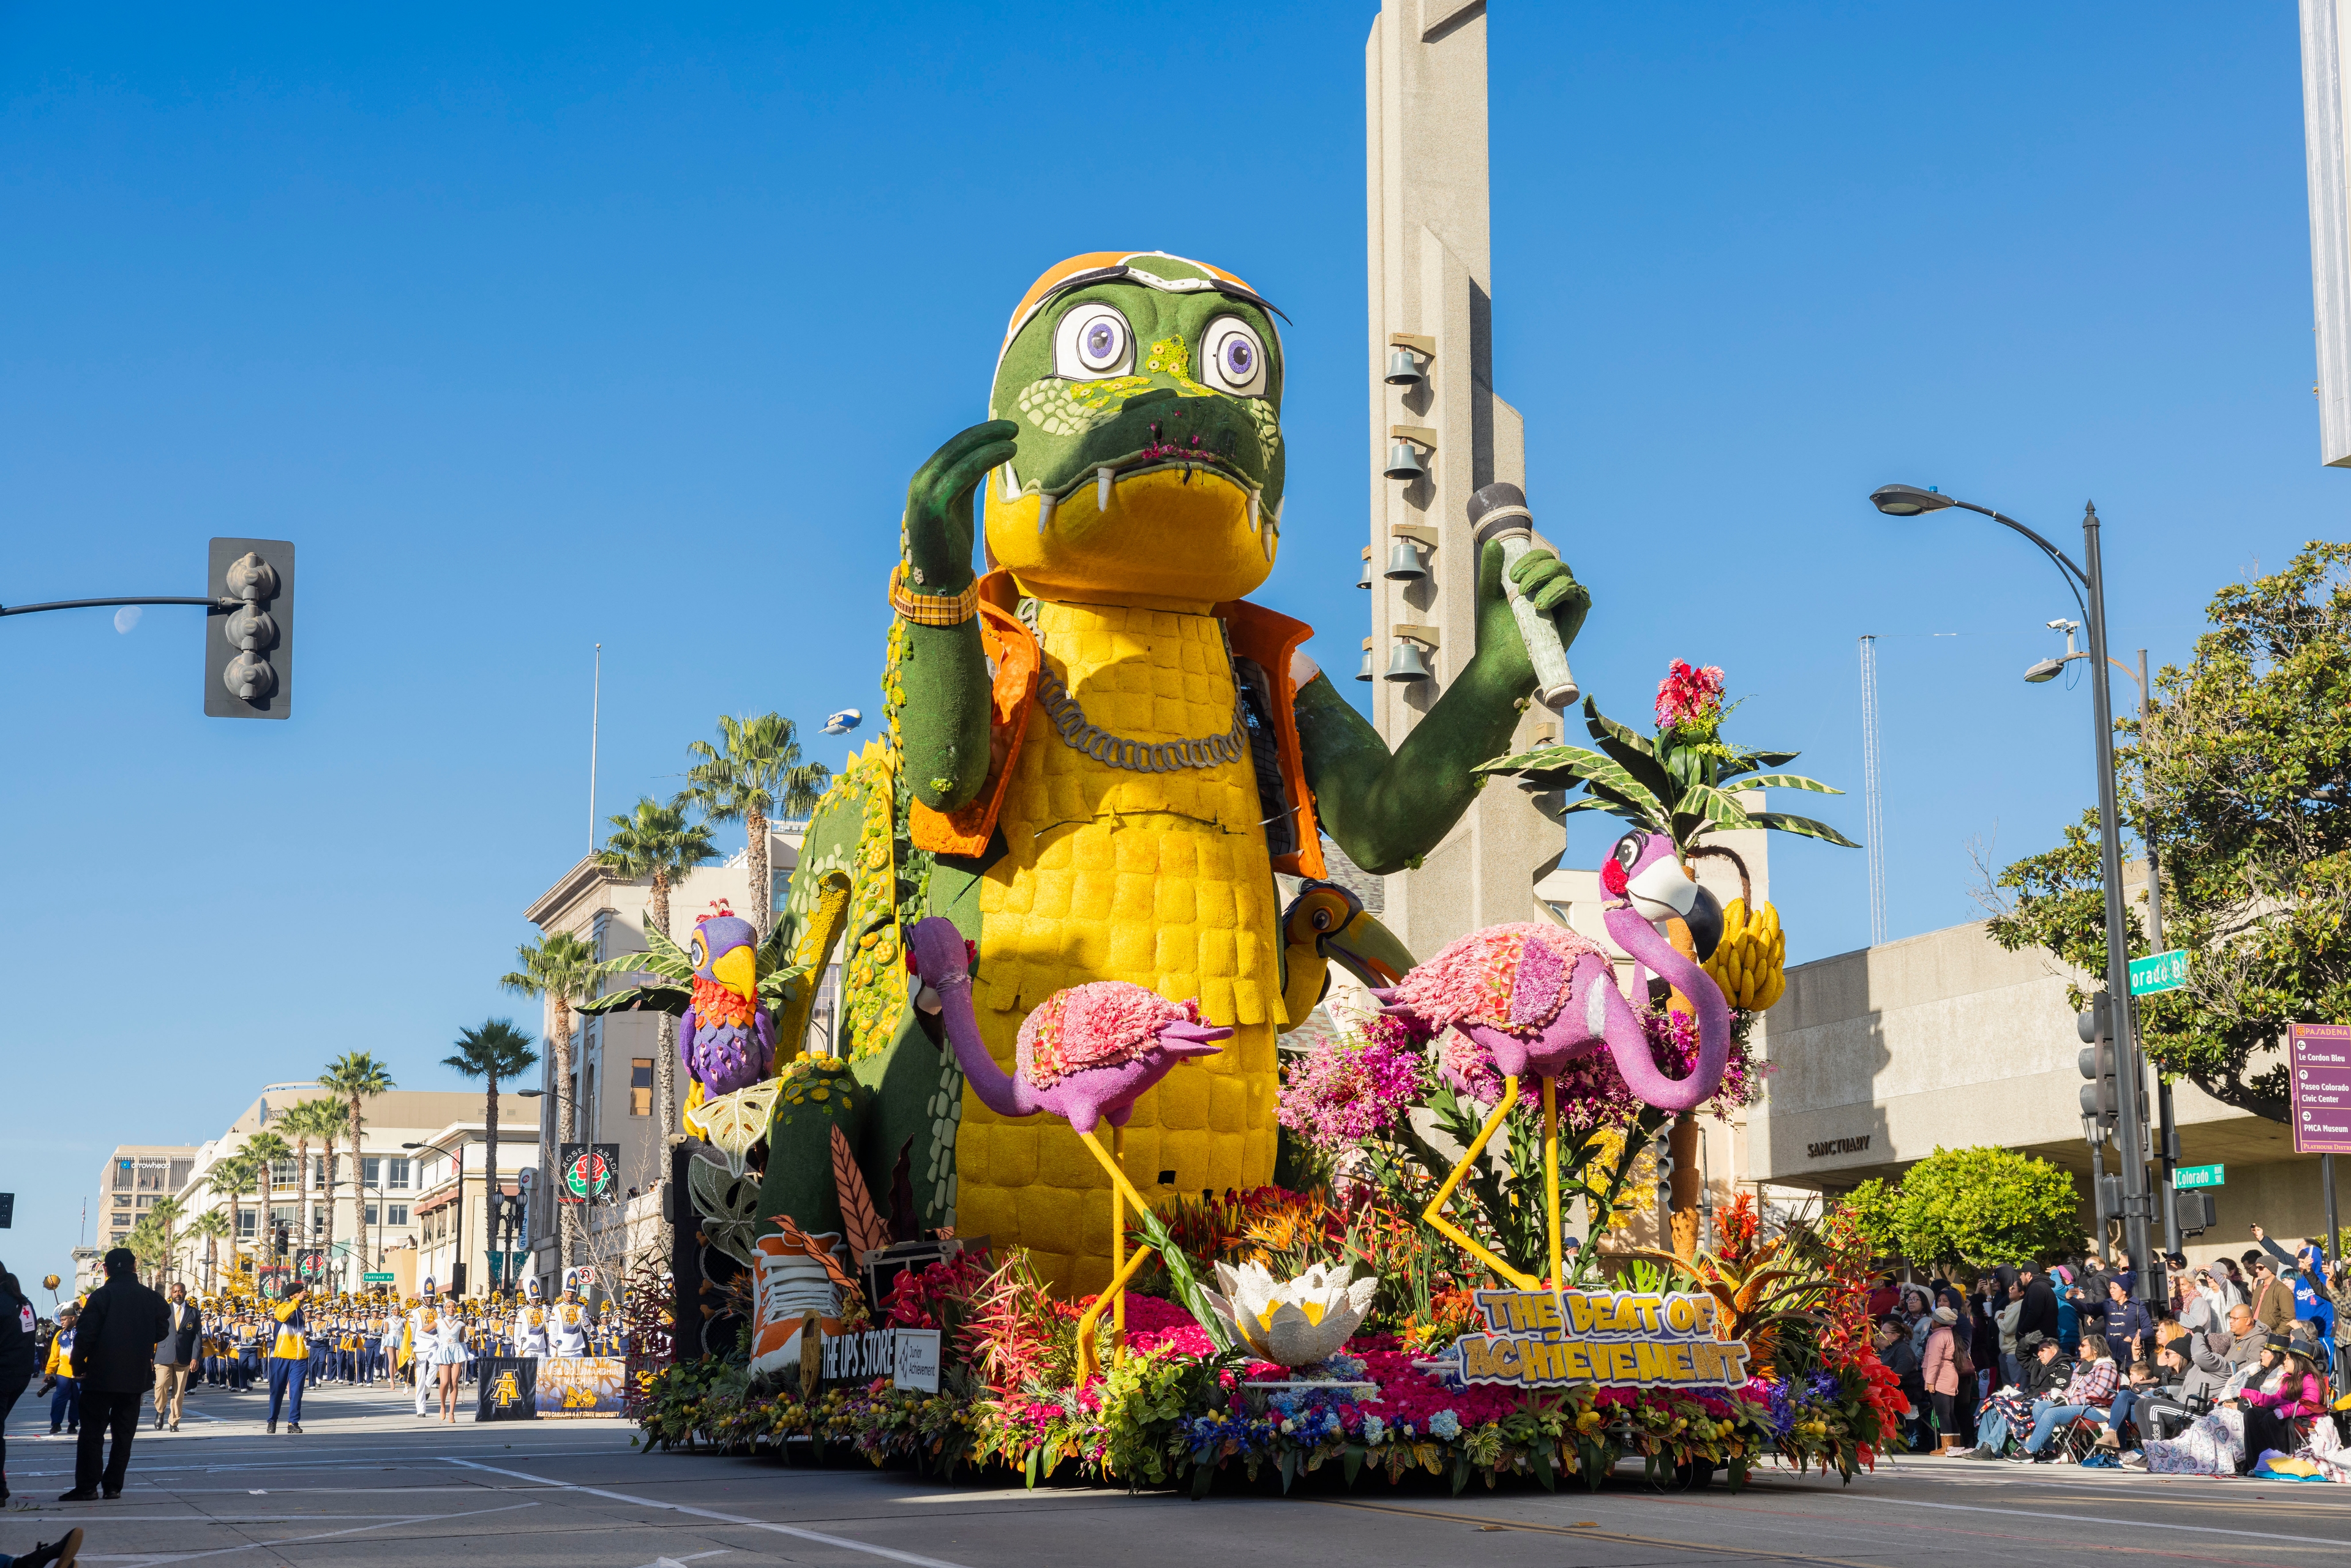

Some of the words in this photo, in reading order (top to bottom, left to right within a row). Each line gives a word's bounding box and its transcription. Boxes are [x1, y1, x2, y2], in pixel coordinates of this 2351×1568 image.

[2131, 964, 2168, 988] orado
[2306, 1027, 2349, 1036] PASADENA
[2321, 1083, 2349, 1092] Colorado
[1807, 1135, 1870, 1158] SANCTUARY
[561, 1147, 584, 1168] ROSE
[593, 1147, 618, 1176] PARADE
[2177, 1169, 2209, 1186] Colorado
[297, 1251, 311, 1264] ROSE
[260, 1274, 272, 1285] ROSE
[1482, 1294, 1561, 1331] THE
[1567, 1295, 1662, 1332] BEAT
[1668, 1296, 1714, 1332] OF
[822, 1336, 839, 1379] THE
[841, 1332, 860, 1378] UPS
[861, 1328, 895, 1376] STORE
[909, 1345, 922, 1359] Junior
[1464, 1330, 1747, 1382] ACHIEVEMENT
[584, 1366, 624, 1376] MARCHING
[909, 1362, 936, 1377] Achievement
[563, 1376, 598, 1385] MACHINE
